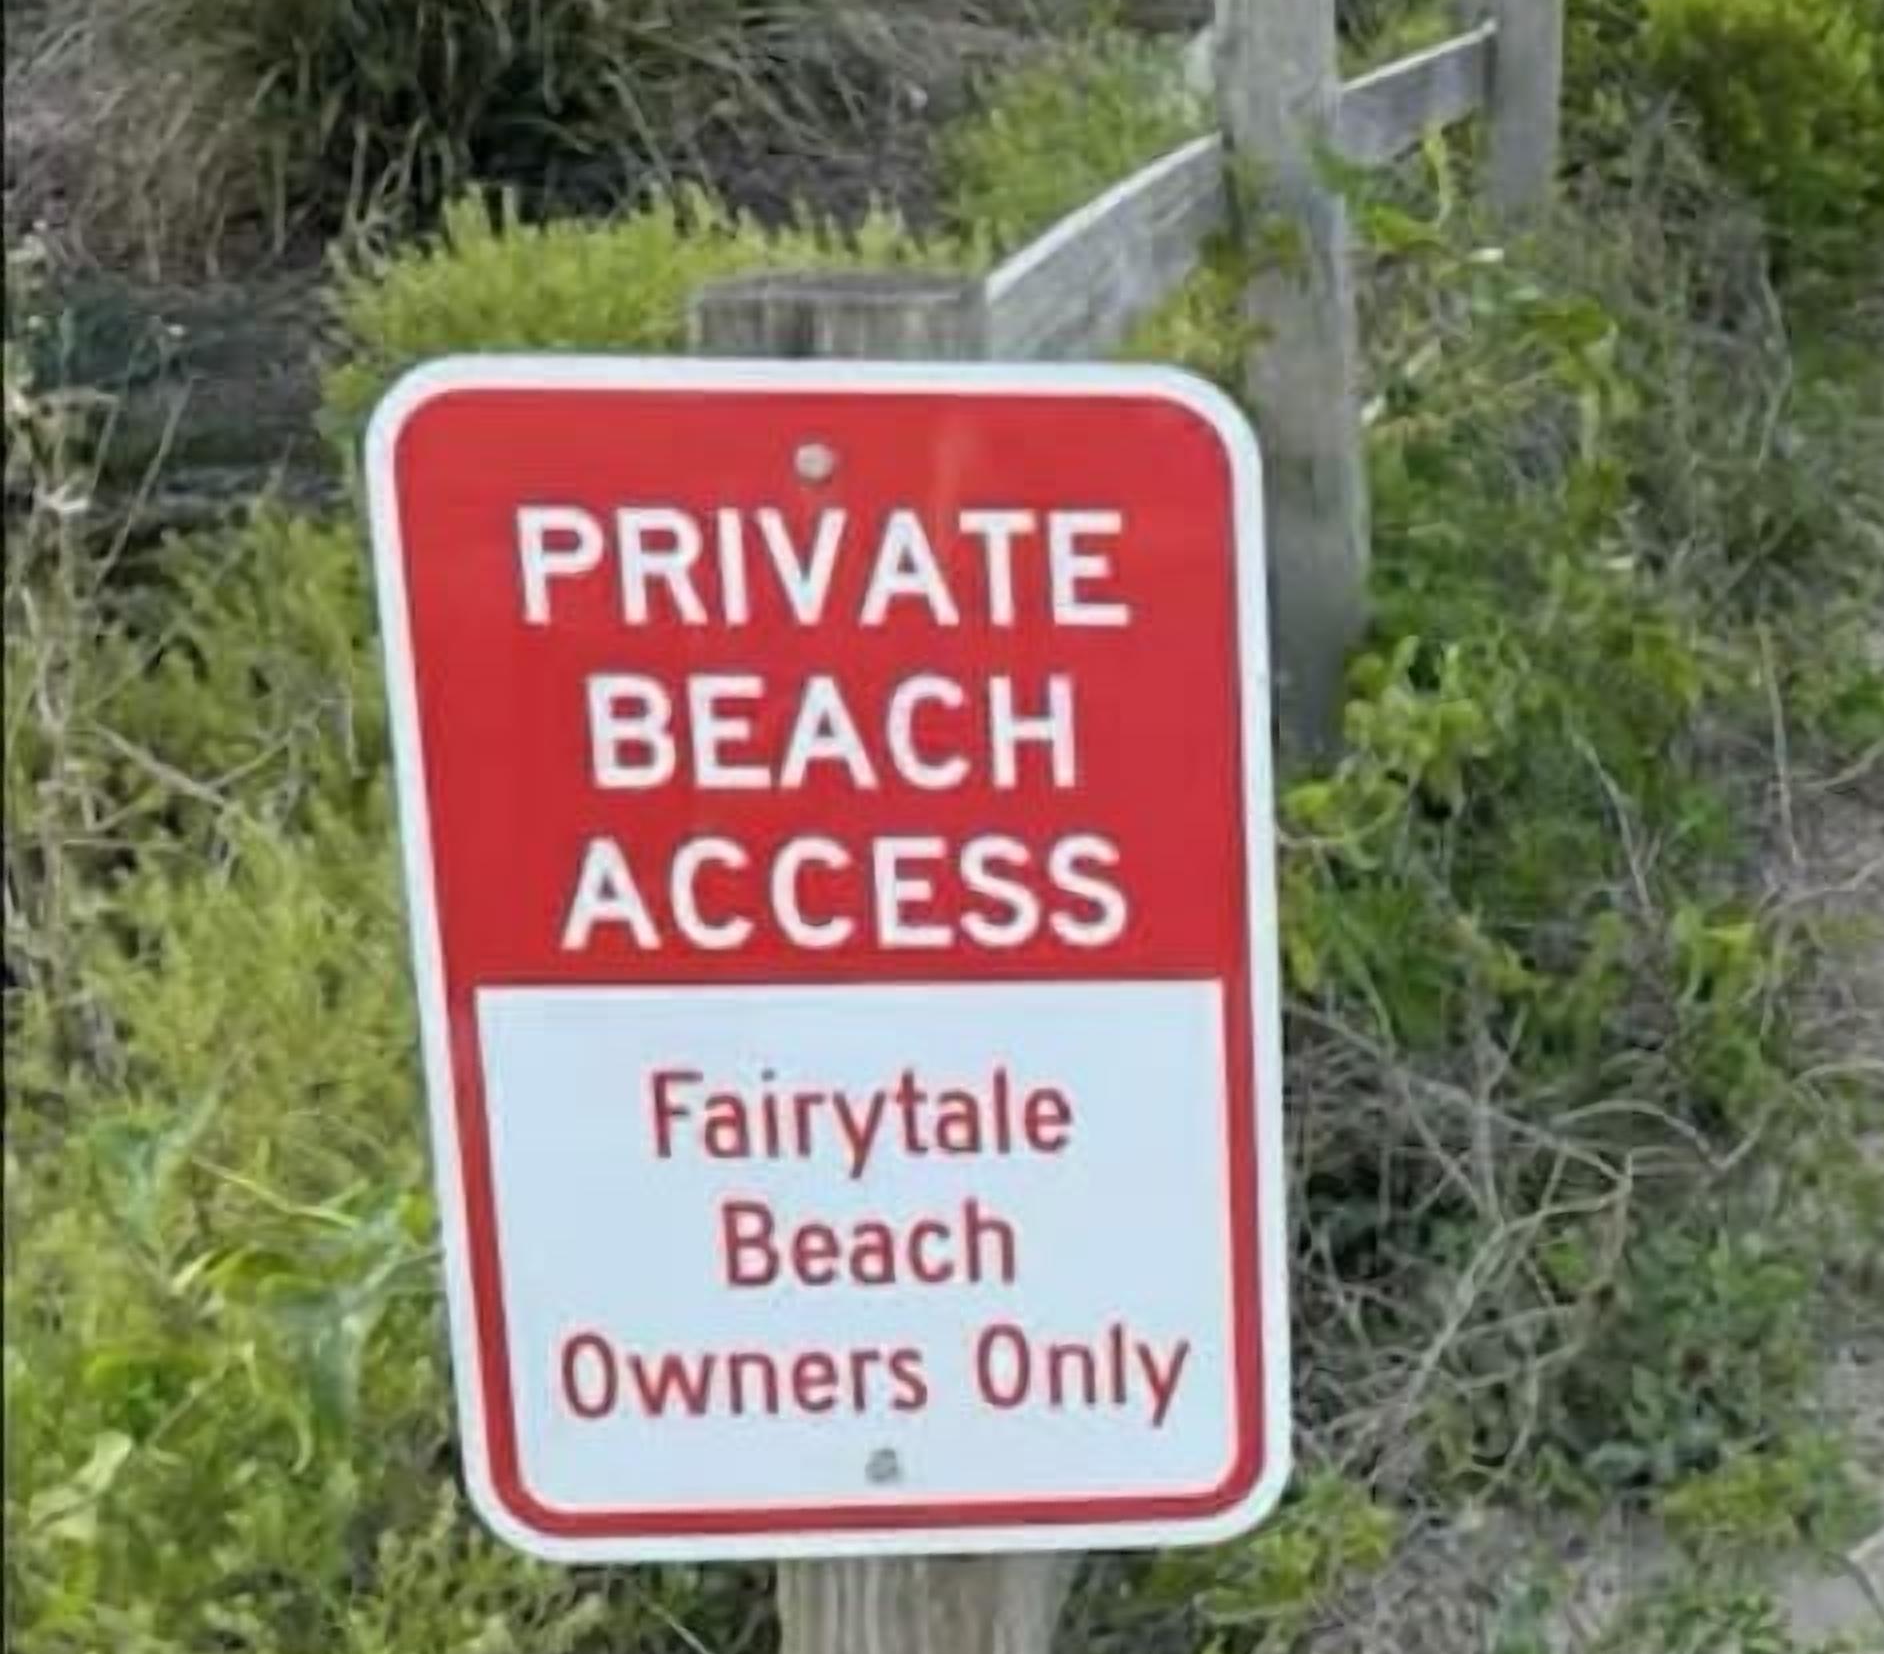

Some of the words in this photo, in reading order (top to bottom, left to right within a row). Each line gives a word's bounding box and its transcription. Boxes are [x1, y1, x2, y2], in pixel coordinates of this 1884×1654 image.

[513, 504, 1132, 627] PRIVATE
[584, 672, 1078, 790] BEACH
[562, 833, 1129, 951] ACCESS
[650, 1069, 1075, 1178] Fairytale
[720, 1199, 1018, 1288] Beach
[560, 1332, 930, 1421] Owners
[976, 1323, 1192, 1426] Only
